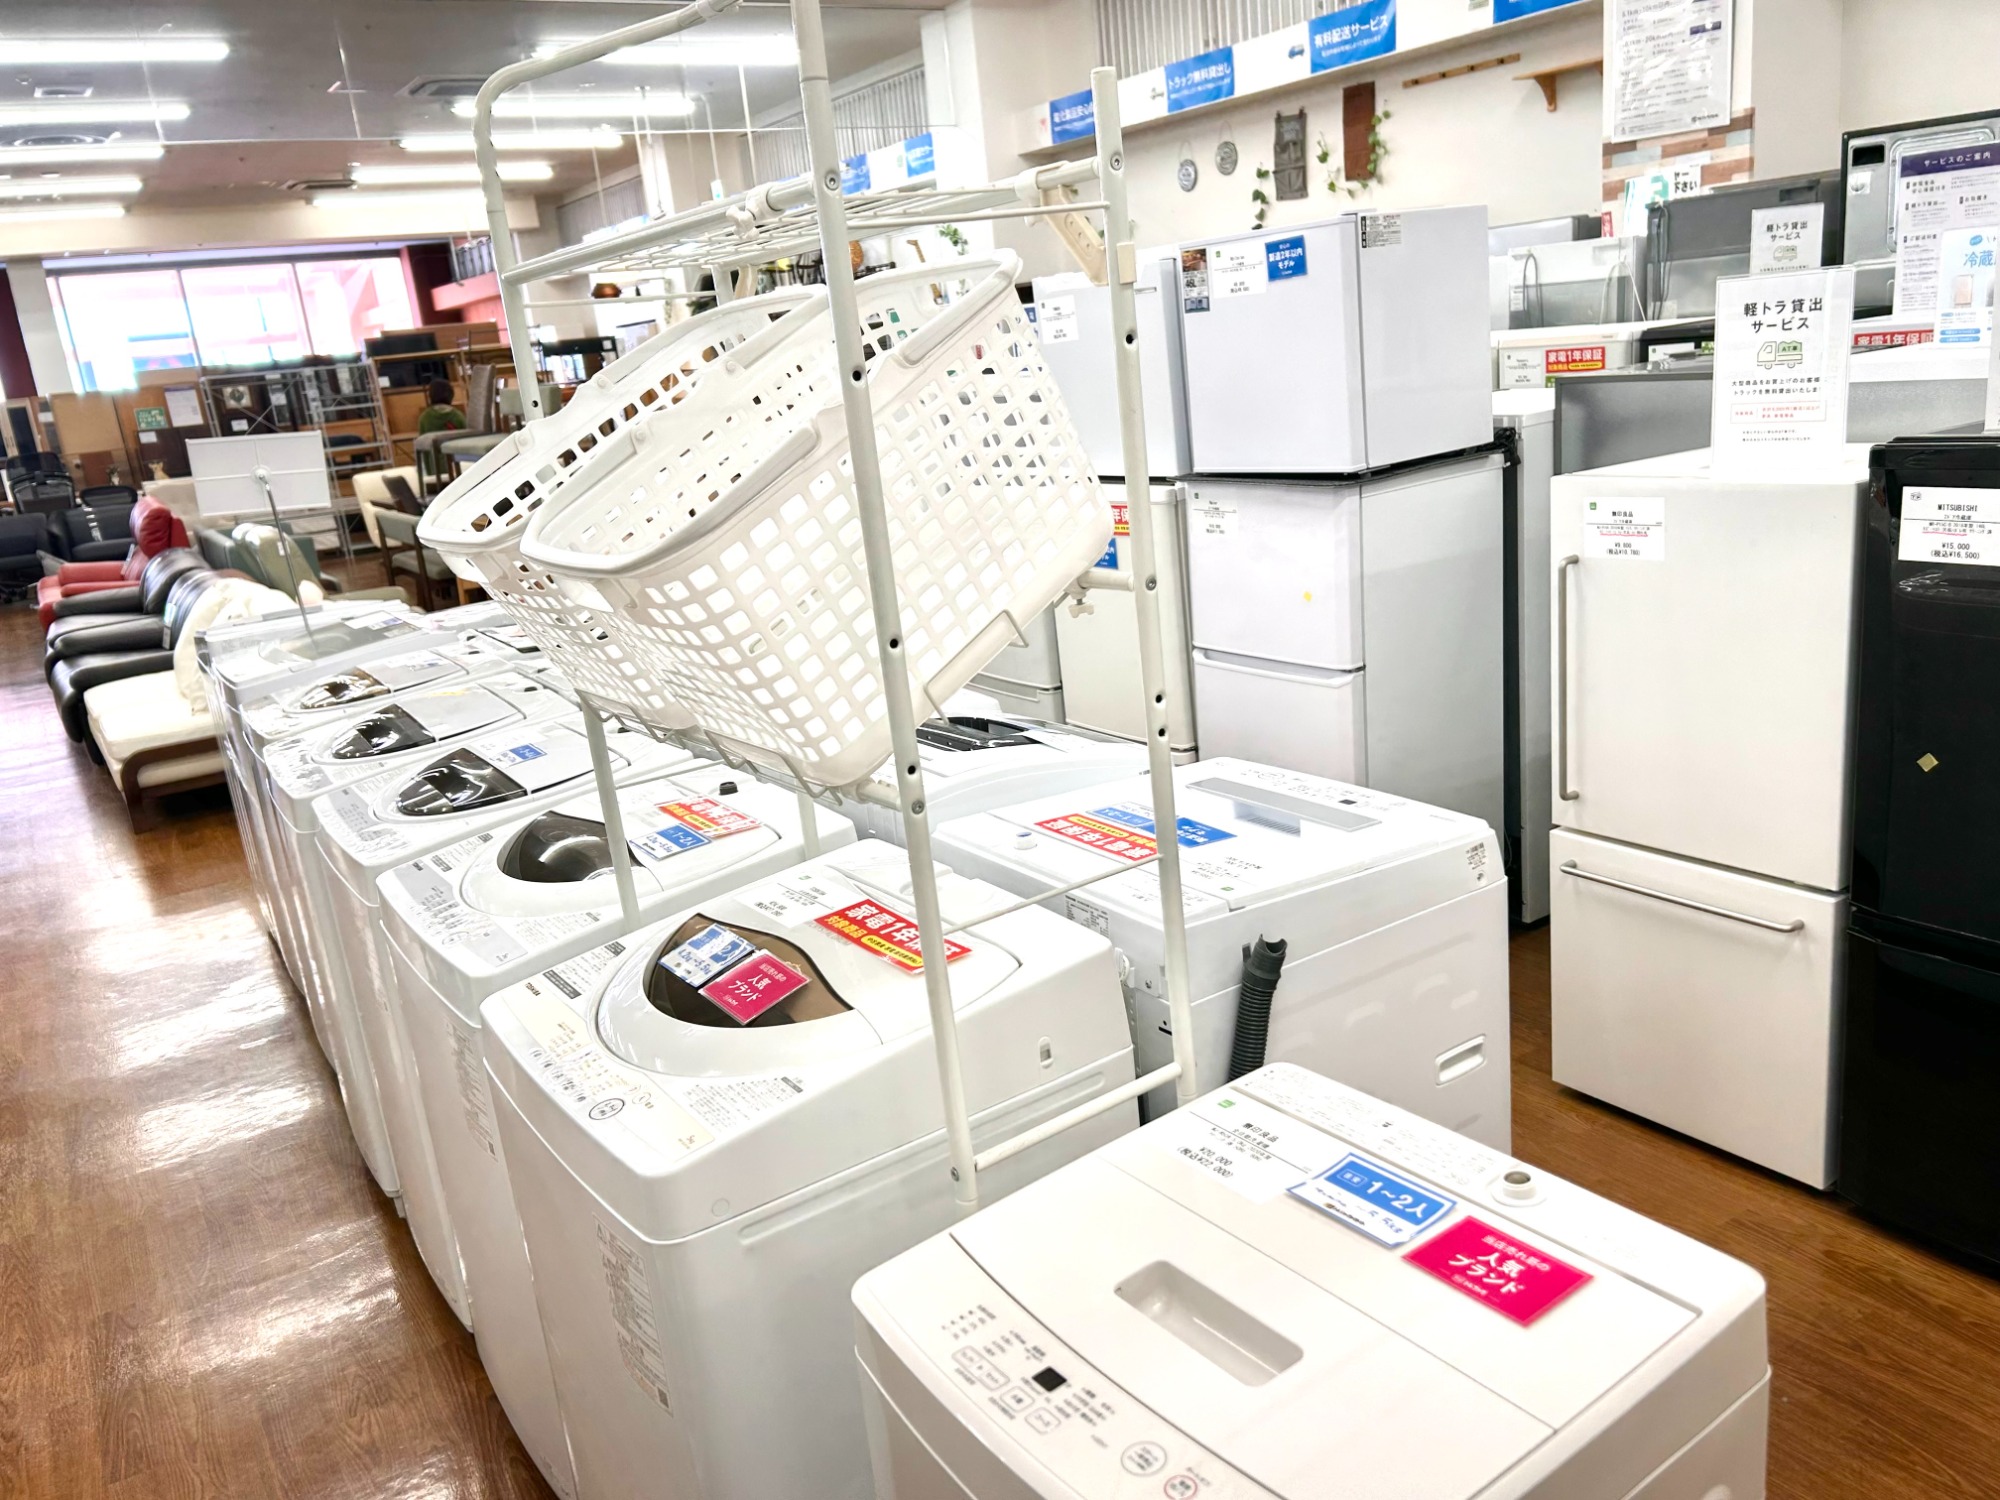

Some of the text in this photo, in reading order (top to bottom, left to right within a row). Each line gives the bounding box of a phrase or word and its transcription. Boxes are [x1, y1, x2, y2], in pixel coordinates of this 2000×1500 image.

[1314, 15, 1388, 48] 有料配送サービス
[1924, 151, 1991, 167] サービスのご案内
[1766, 221, 1808, 232] 軽トラ貸出
[1770, 232, 1801, 241] サービス
[1963, 250, 1997, 268] 冷蔵
[1744, 297, 1823, 317] 軽トラ貸出
[1751, 316, 1809, 333] サービス
[1547, 348, 1603, 363] 家電1年保証
[1734, 387, 1822, 395] トラックを無料貸出いたしま
[1937, 504, 1978, 512] MITSUBISHI
[824, 915, 868, 938] 対象商品
[728, 980, 762, 1002] ブランド
[748, 974, 771, 990] 人気
[1241, 1122, 1279, 1143] 無印良品
[1481, 1235, 1551, 1272] 当店売れ筋の
[1448, 1254, 1525, 1294] ブランド
[1475, 1252, 1523, 1278] 人気
